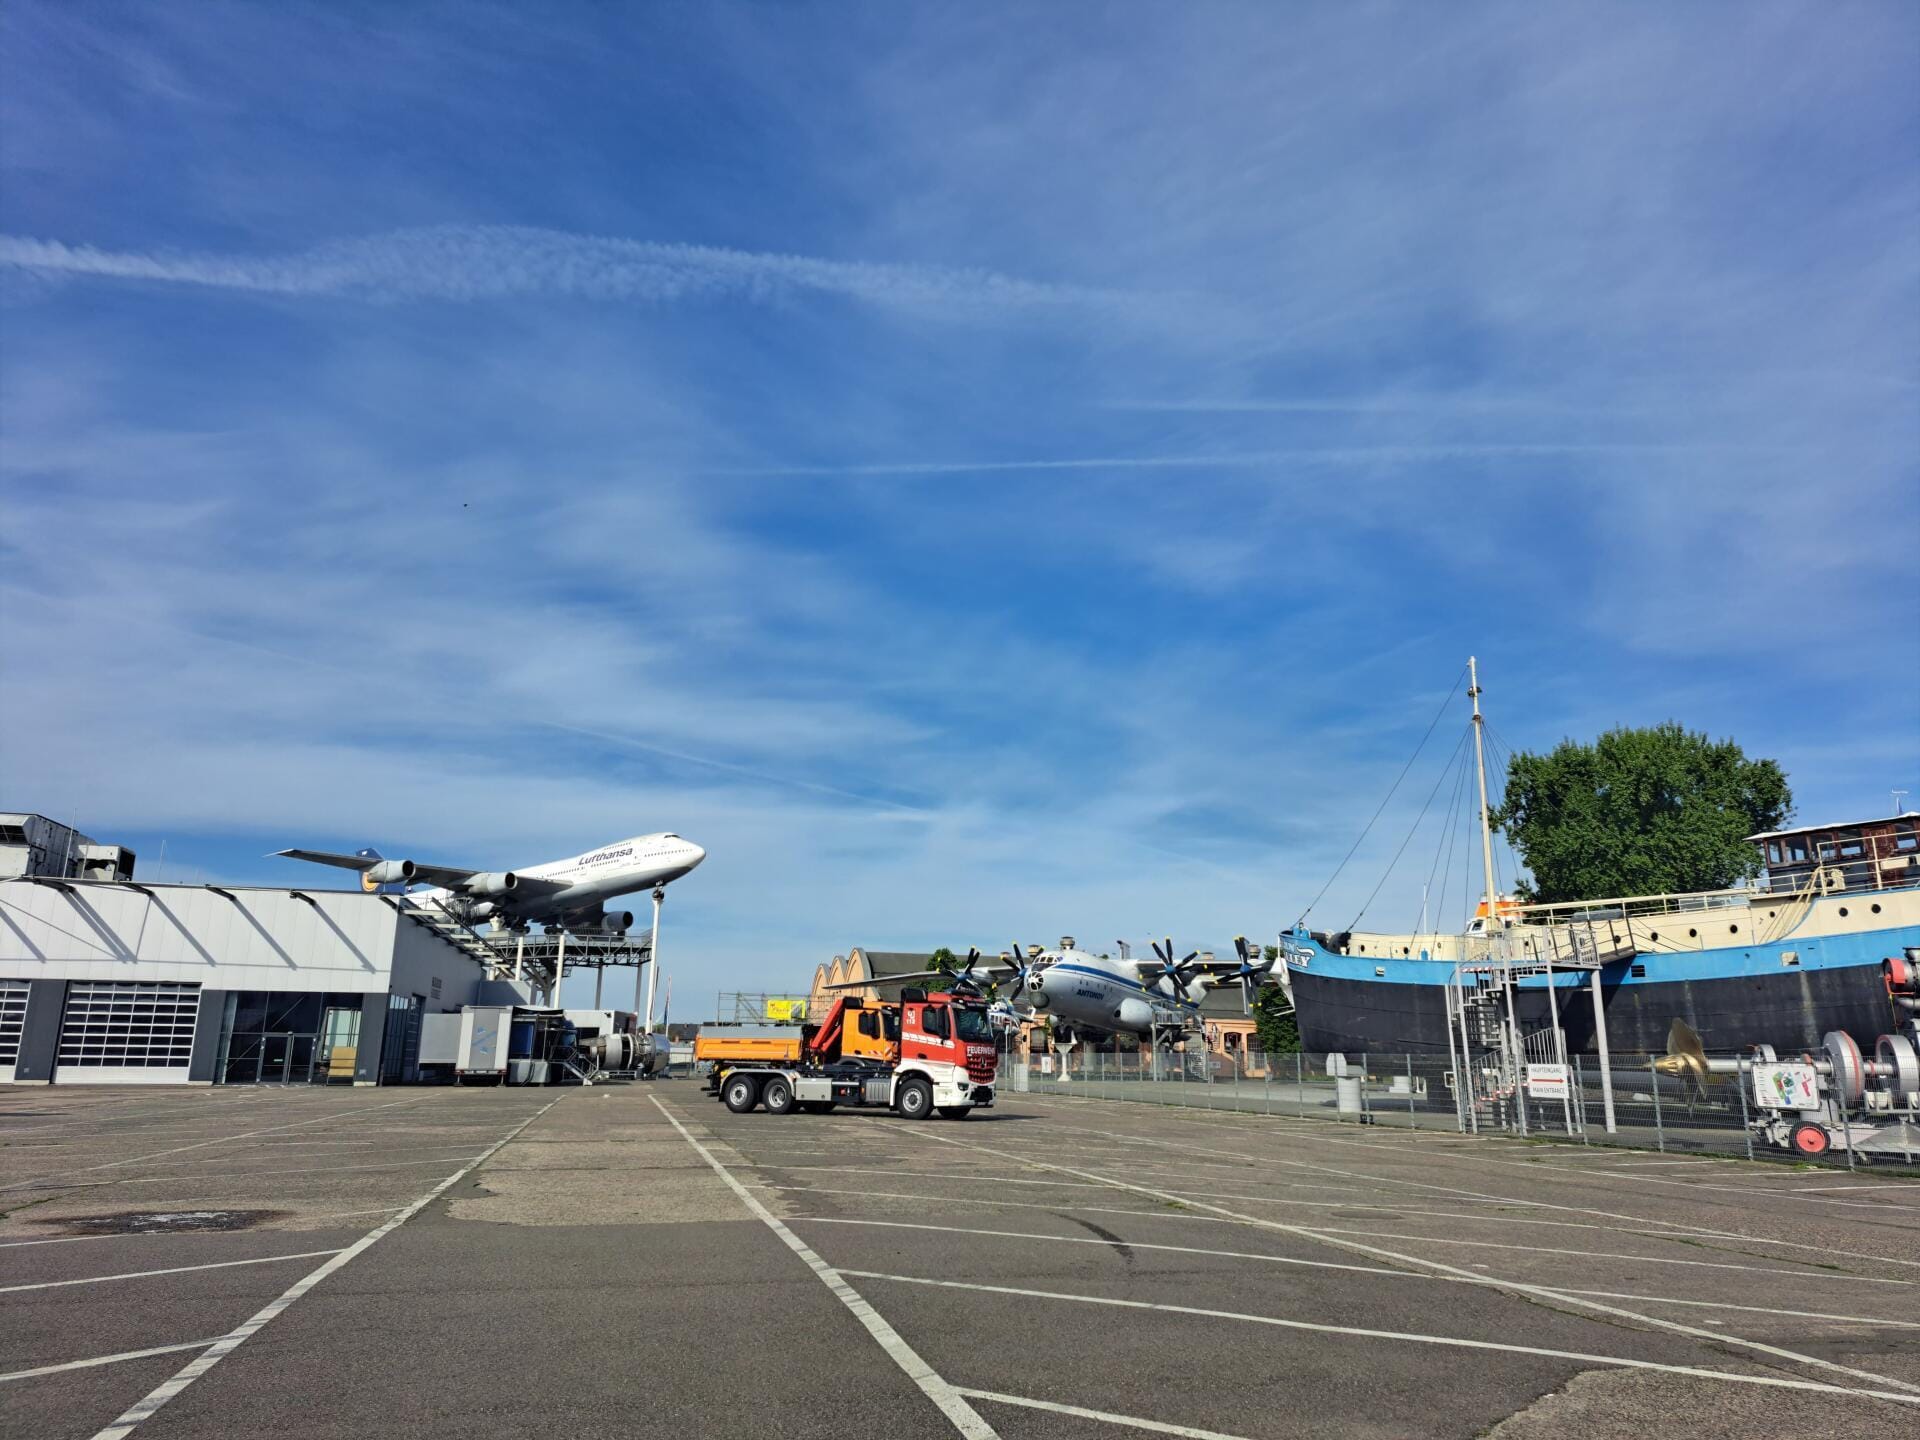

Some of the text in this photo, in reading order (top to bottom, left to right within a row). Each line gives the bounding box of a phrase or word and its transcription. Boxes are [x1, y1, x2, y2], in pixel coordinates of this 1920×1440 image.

[578, 847, 633, 866] Lufthansa
[1076, 989, 1105, 1001] ANTONOV
[966, 1045, 995, 1056] FEUERWEHR
